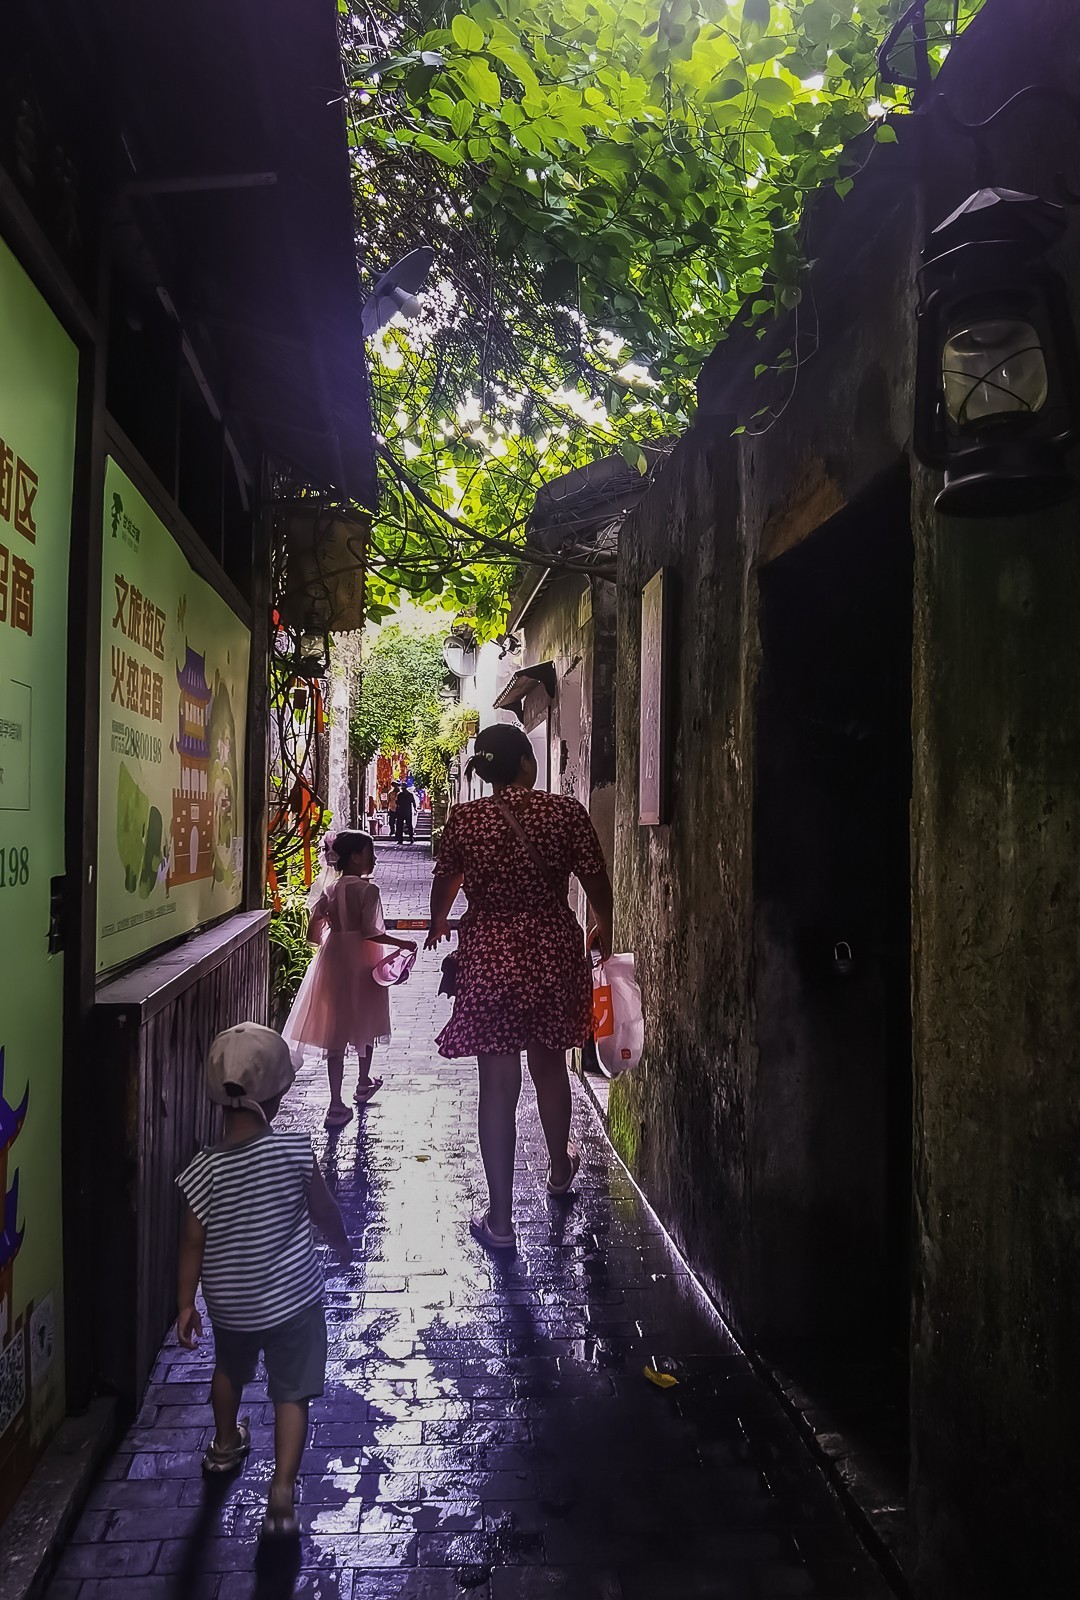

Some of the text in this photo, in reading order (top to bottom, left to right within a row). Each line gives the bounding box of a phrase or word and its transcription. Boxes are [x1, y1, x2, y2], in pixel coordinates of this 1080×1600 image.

[112, 573, 166, 661] 文旅街区
[111, 645, 163, 723] 火热招商
[125, 726, 162, 764] 28800198
